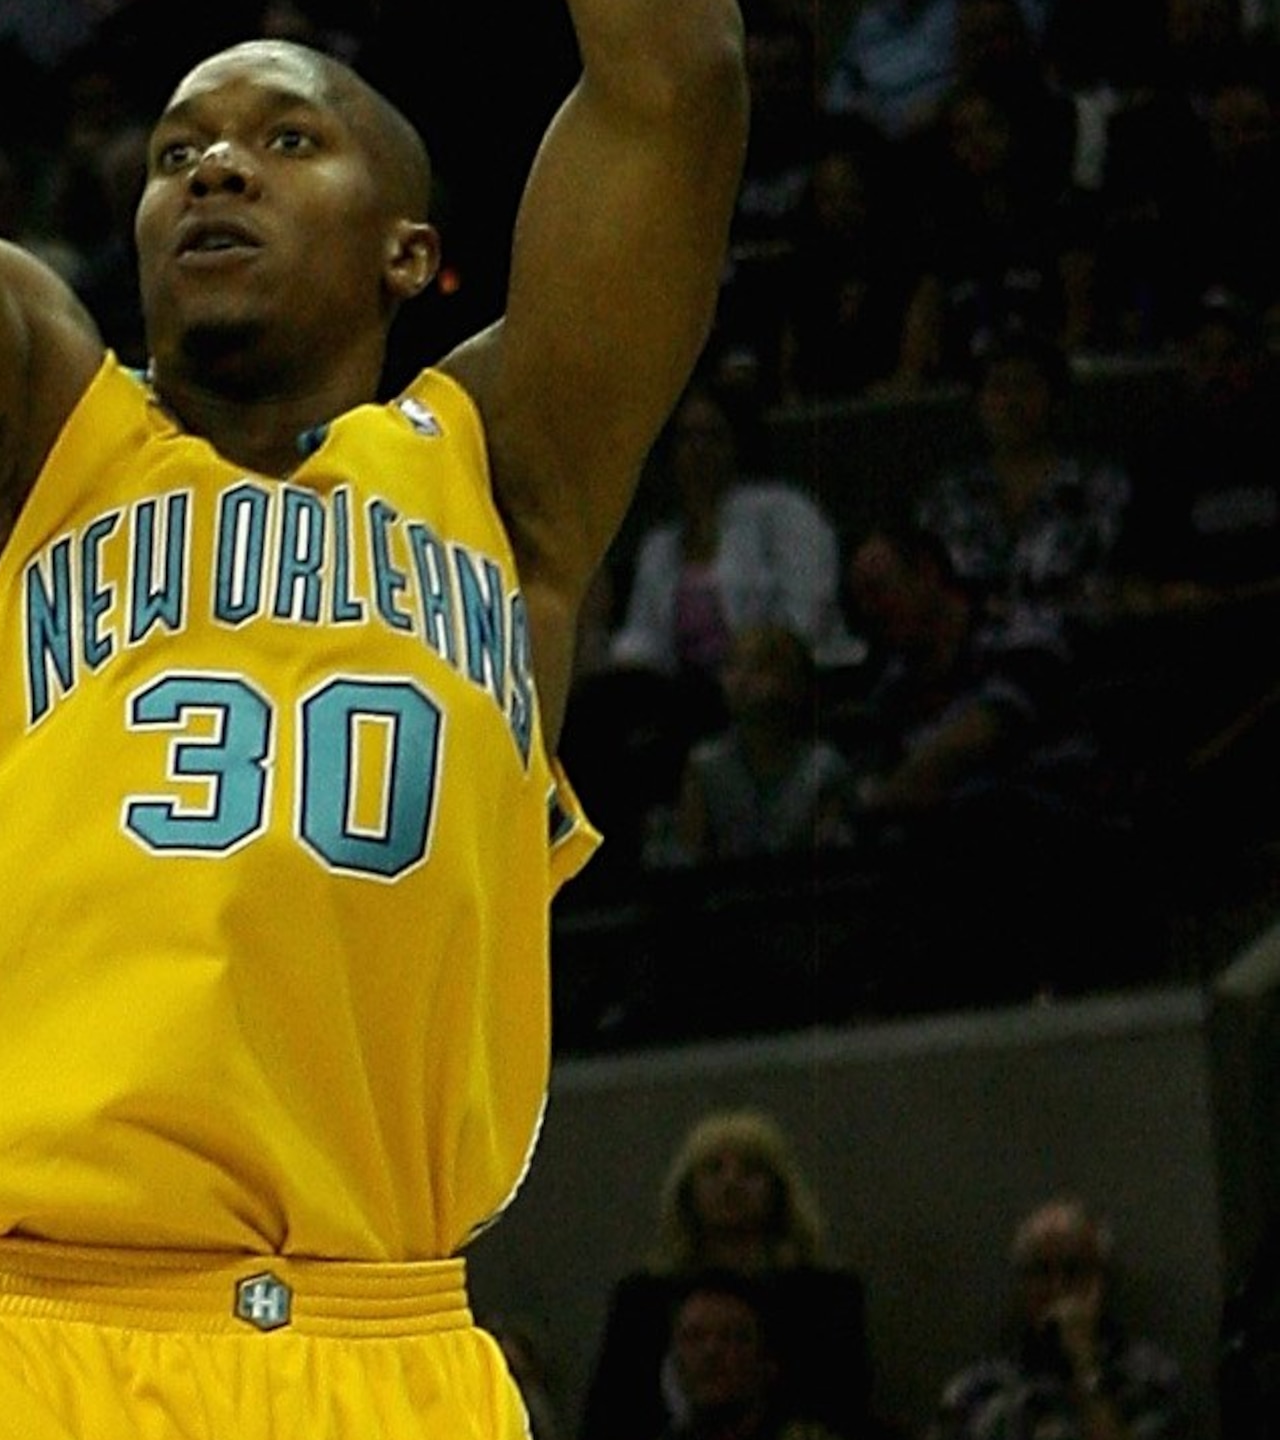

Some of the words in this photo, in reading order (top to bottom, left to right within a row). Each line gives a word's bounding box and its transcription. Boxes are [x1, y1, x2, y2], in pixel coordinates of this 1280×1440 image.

[22, 488, 191, 732] NEW
[214, 481, 533, 779] ORLEANS
[121, 670, 443, 884] 30
